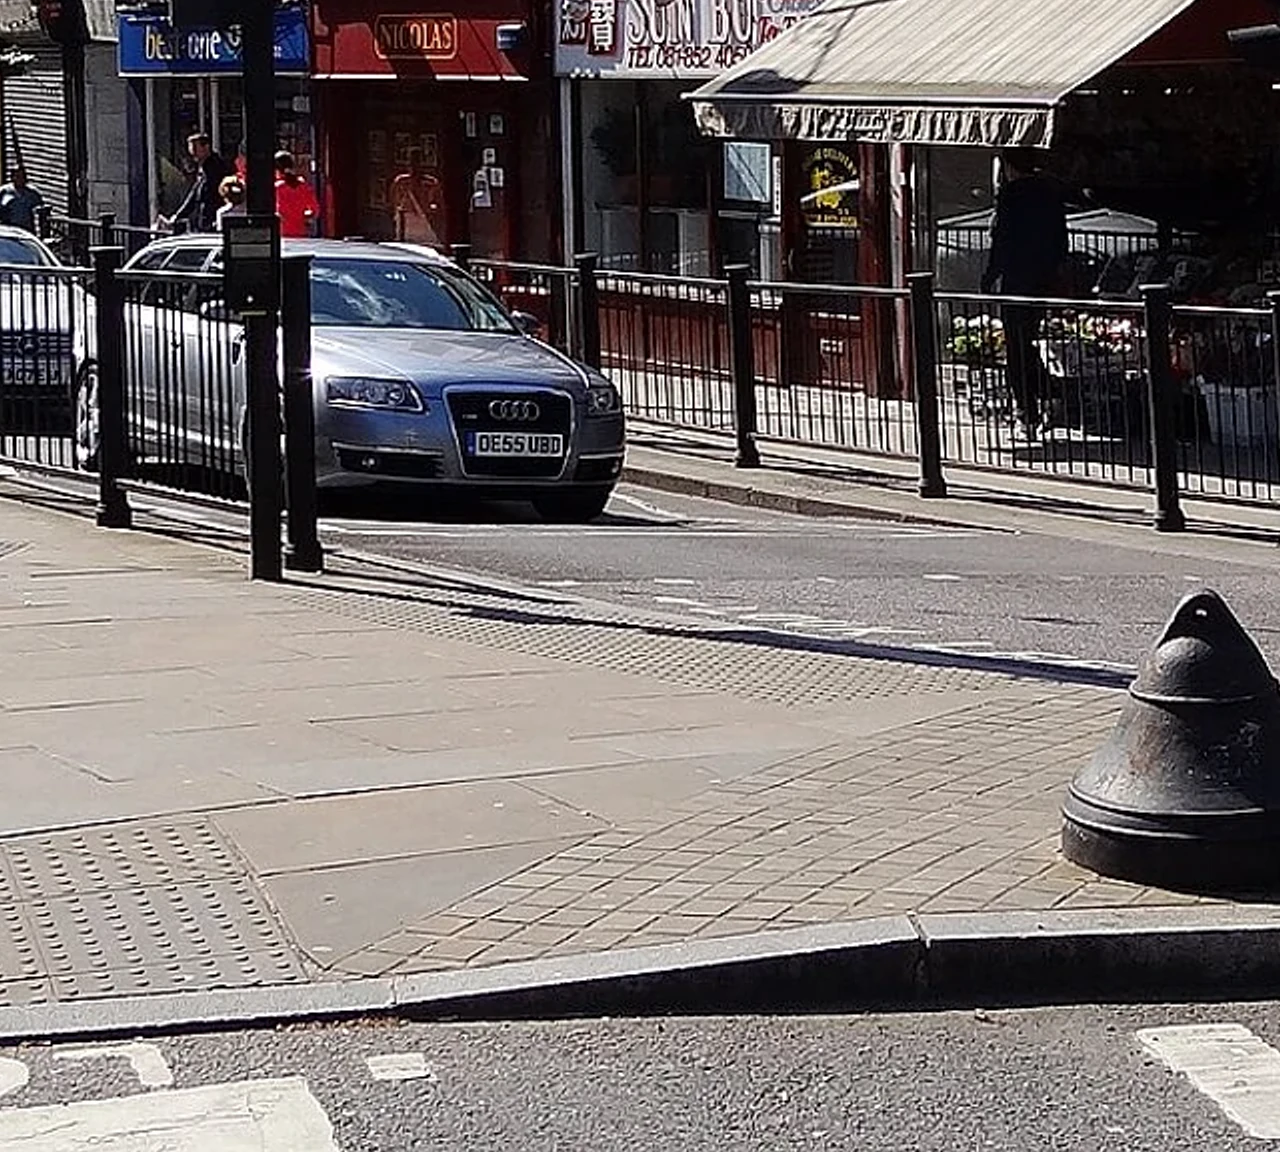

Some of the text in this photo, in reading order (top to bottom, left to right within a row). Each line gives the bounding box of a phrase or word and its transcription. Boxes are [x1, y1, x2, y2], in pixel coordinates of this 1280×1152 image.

[378, 20, 453, 52] NICOLAS
[627, 46, 655, 69] TEL
[528, 436, 562, 454] UBD
